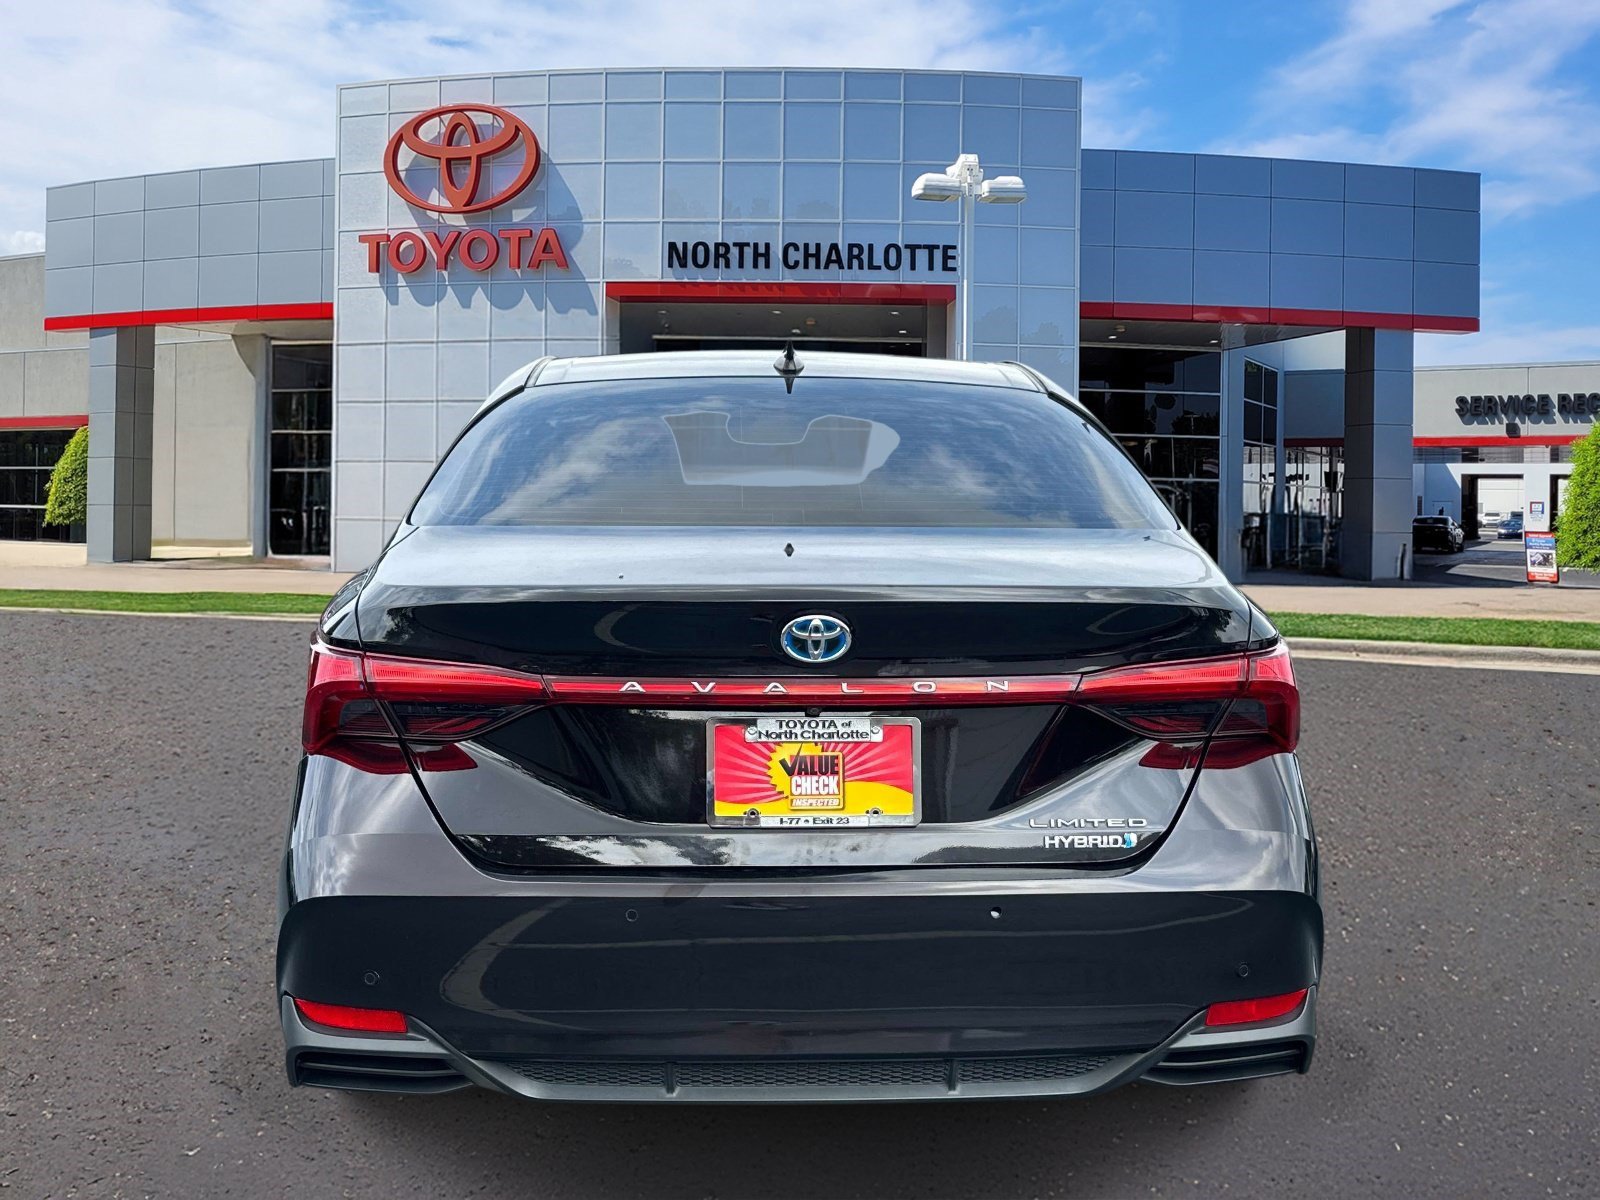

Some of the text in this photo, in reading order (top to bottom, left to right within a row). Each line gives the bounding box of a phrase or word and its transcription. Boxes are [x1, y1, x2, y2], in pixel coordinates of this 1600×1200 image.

[359, 228, 569, 273] TOYOTA
[667, 241, 957, 271] NORTH CHARLOTTE
[1455, 394, 1551, 417] SERVICE
[619, 680, 1009, 694] AVALON
[775, 719, 853, 730] TOYOTA of
[758, 730, 870, 740] North Charlotte
[779, 744, 839, 776] VALUE
[791, 775, 839, 796] CHECK
[791, 798, 839, 807] INSPECTED
[812, 817, 835, 825] Exit
[836, 817, 850, 825] 23
[1029, 818, 1148, 828] LIMITED
[1044, 835, 1123, 849] HYBRID
